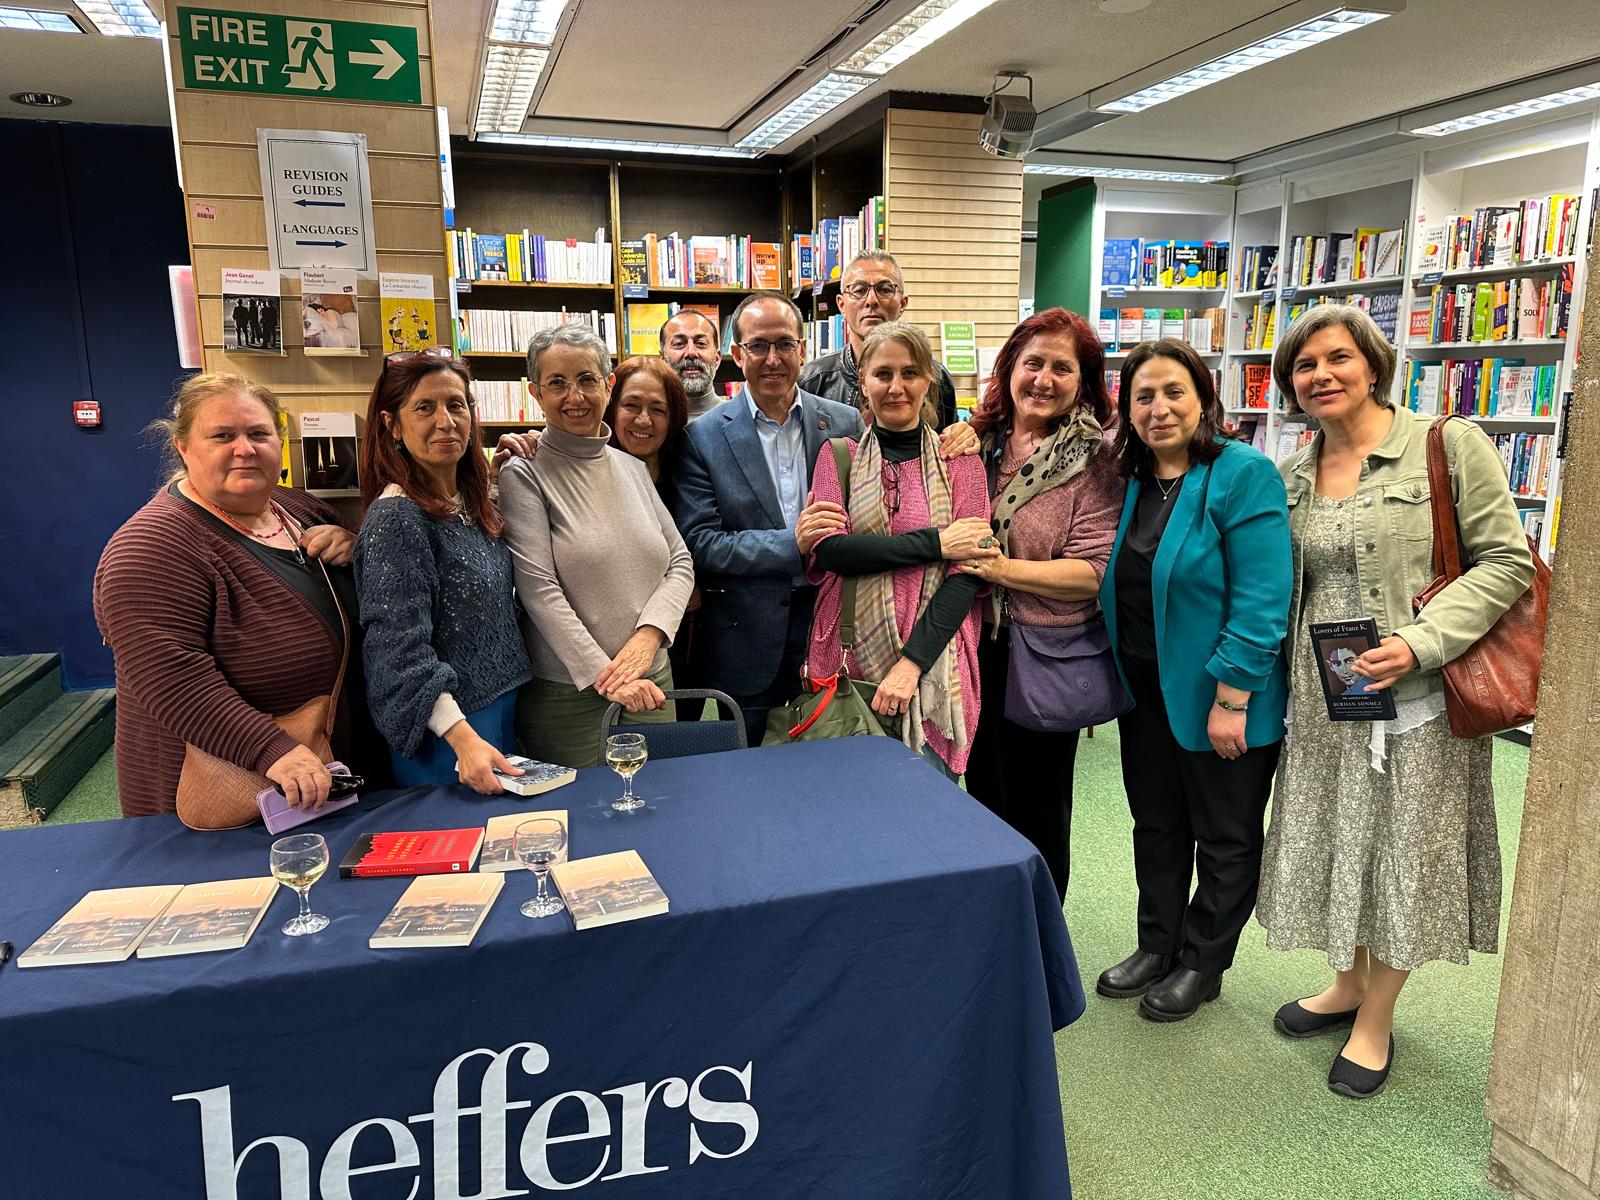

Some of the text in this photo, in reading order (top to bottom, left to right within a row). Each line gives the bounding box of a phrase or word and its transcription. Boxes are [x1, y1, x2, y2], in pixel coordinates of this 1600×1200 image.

[190, 14, 269, 46] FIRE
[194, 55, 270, 85] EXIT
[283, 169, 349, 182] REVISION
[292, 185, 343, 197] GUIDES
[282, 224, 359, 236] LANGUAGES
[1523, 308, 1540, 317] SOLV
[1248, 367, 1266, 378] THIS
[1313, 627, 1333, 635] Lovers
[1359, 623, 1368, 631] K.
[620, 879, 649, 888] BURHAN
[172, 1042, 760, 1200] heffers
